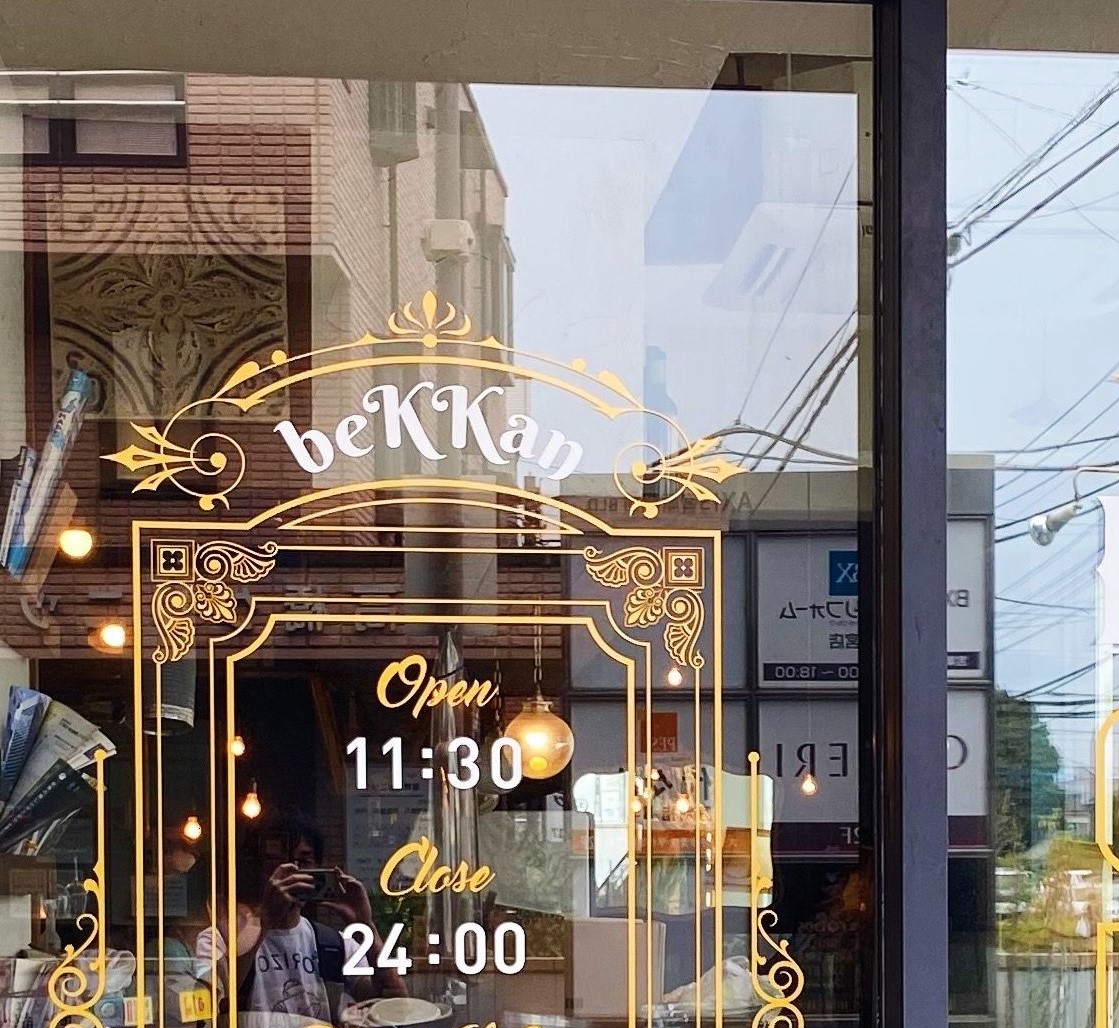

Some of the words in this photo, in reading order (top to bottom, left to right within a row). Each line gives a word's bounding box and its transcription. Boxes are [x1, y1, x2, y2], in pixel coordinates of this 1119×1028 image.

[274, 380, 587, 482] beKKan
[376, 653, 500, 718] Open
[346, 735, 523, 792] 11:30
[379, 835, 497, 898] Close
[341, 921, 527, 976] 24:00
